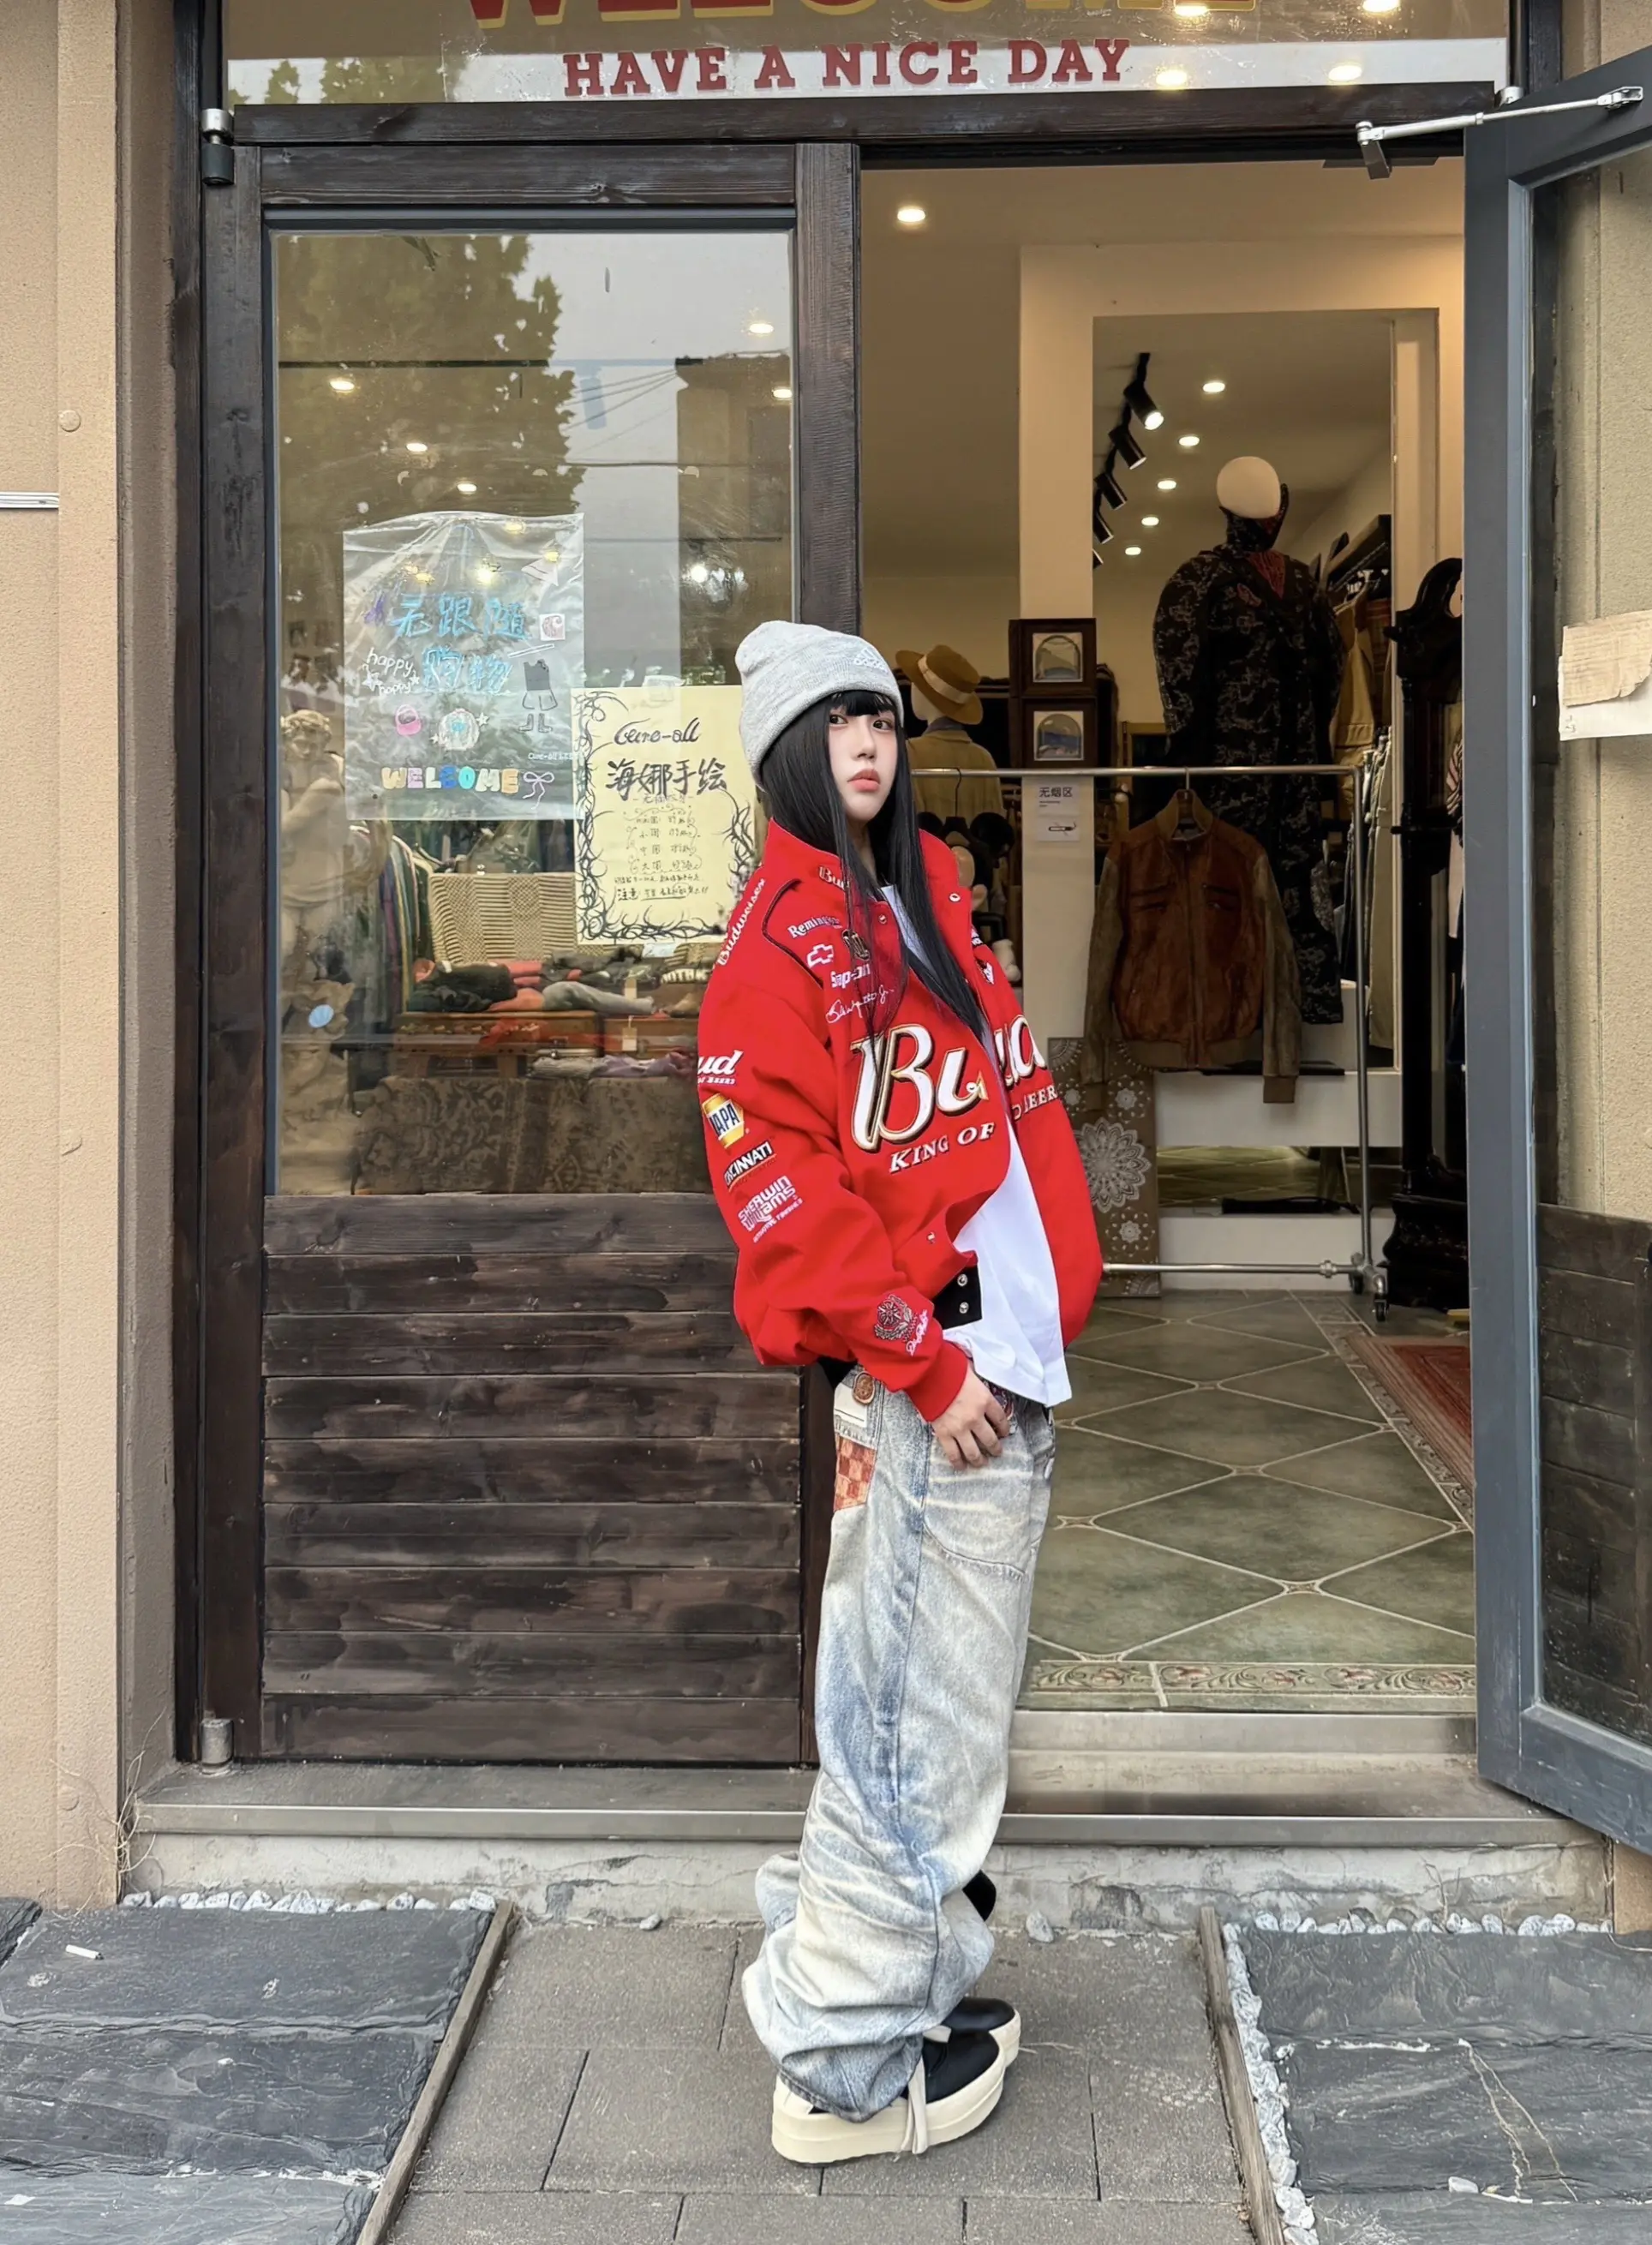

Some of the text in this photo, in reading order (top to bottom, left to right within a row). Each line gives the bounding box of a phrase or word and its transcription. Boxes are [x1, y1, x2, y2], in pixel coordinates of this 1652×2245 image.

[563, 39, 1130, 97] HAVE A NICE DAY
[366, 647, 414, 678] happy
[605, 757, 727, 801] 海娜手绘
[1038, 787, 1073, 797] 无烟区
[716, 877, 766, 967] Budweiser
[697, 1049, 745, 1075] ud
[888, 1134, 950, 1174] KING
[956, 1121, 997, 1146] OF
